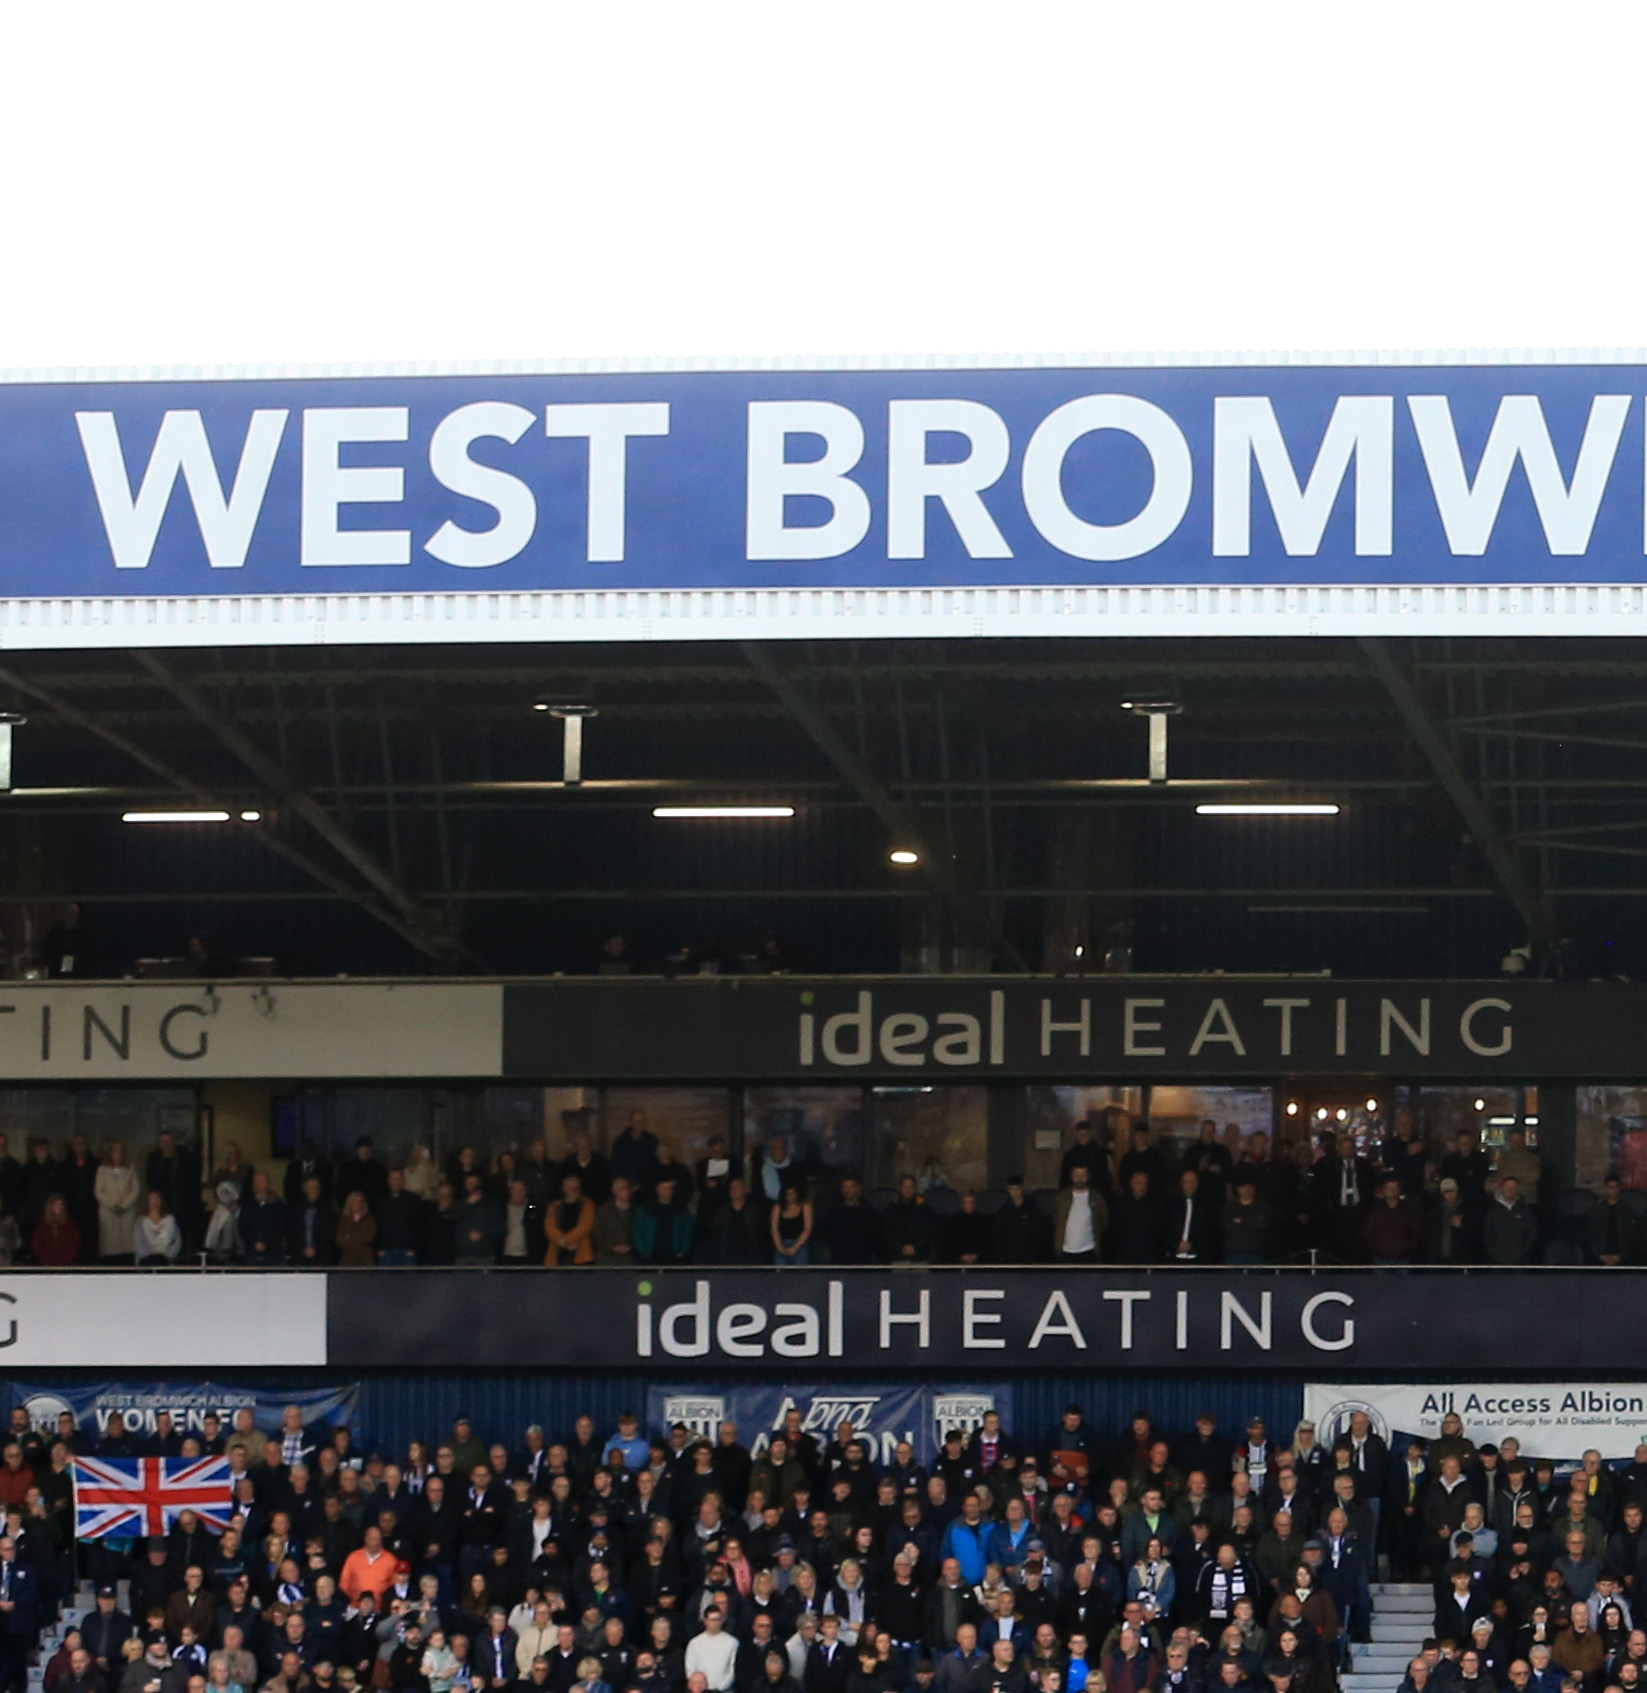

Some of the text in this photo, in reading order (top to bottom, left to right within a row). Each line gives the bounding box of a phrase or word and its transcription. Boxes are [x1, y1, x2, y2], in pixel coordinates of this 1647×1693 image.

[75, 401, 669, 568] WEST
[0, 1003, 209, 1061] ING
[800, 991, 1512, 1066] ideal HEATING
[638, 1281, 1354, 1356] ideal HEATING
[668, 1407, 718, 1419] ALBION
[1420, 1418, 1436, 1426] The
[1467, 1418, 1483, 1426] Fan
[1507, 1417, 1535, 1428] Group
[1539, 1416, 1551, 1426] for
[1556, 1416, 1569, 1425] All
[1572, 1415, 1611, 1425] Disabled
[1421, 1391, 1643, 1413] All Access Albion
